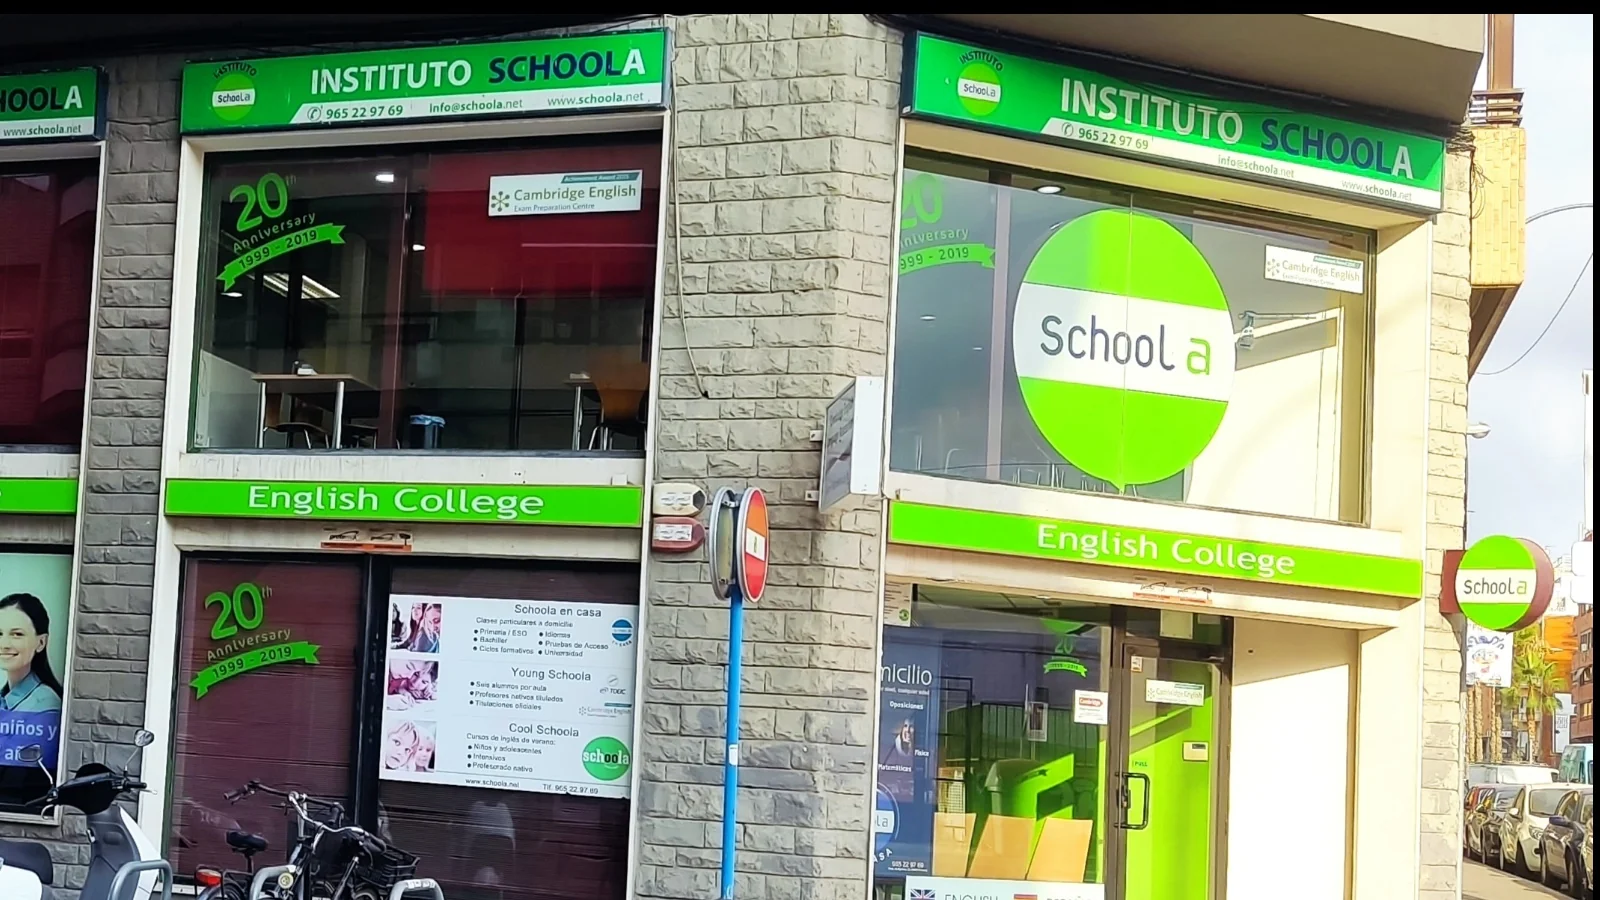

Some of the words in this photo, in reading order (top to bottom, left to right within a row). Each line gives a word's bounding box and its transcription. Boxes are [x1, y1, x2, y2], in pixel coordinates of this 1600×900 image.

[960, 50, 1003, 71] INSTITUTO
[213, 62, 257, 79] INSTITUTO
[311, 59, 472, 95] INSTITUTO
[489, 48, 646, 84] SCHOOLA
[326, 108, 349, 119] 965
[352, 107, 366, 118] 22
[370, 106, 385, 117] 97
[388, 105, 404, 116] 69
[547, 92, 644, 107] www.schoola.net
[3, 124, 82, 137] www.schoola.net
[1061, 76, 1244, 145] INSTITUTO
[1261, 118, 1414, 180] SCHOOLA
[1078, 127, 1099, 141] 965
[1101, 131, 1117, 145] 22
[1119, 135, 1132, 147] 97
[1135, 138, 1149, 150] 69
[1217, 155, 1295, 179] info@schoola.net
[1341, 180, 1412, 202] www.schoola.net
[514, 186, 585, 201] Cambridge
[589, 184, 636, 199] English
[533, 204, 571, 212] Preparation
[233, 212, 316, 254] Anniversary
[239, 247, 270, 269] 1999
[285, 229, 317, 249] 2019
[938, 246, 969, 260] 2019
[1282, 260, 1329, 277] Cambridge
[1330, 268, 1360, 282] English
[1040, 314, 1211, 376] Schoola
[249, 485, 378, 515] English
[393, 487, 544, 520] College
[1037, 523, 1158, 559] English
[1171, 538, 1296, 578] College
[1463, 577, 1527, 595] Schoola
[514, 604, 557, 615] Schoola
[560, 607, 573, 616] en
[576, 609, 602, 617] casa
[499, 618, 537, 627] particulares
[544, 620, 573, 628] domicilio
[479, 628, 507, 636] Primaria
[512, 629, 528, 637] ESO
[479, 636, 508, 644] Bachiller
[207, 628, 291, 661] Anniversary
[479, 645, 499, 653] Ciclos
[500, 646, 534, 655] formativos
[545, 640, 572, 648] Pruebas
[584, 642, 609, 650] Acceso
[544, 649, 583, 657] Universidad
[212, 658, 244, 679] 1999
[260, 646, 292, 662] 2019
[511, 666, 545, 681] Young
[548, 669, 591, 681] Schoola
[491, 682, 519, 690] alumnos
[520, 684, 531, 692] por
[475, 690, 510, 699] Profesores
[511, 692, 534, 701] nativos
[535, 694, 564, 703] titulados
[475, 699, 514, 709] Titulaciones
[514, 702, 542, 711] oficiales
[889, 700, 924, 710] Oposiciones
[0, 719, 44, 737] niños
[47, 725, 58, 741] y
[466, 732, 489, 740] Cursos
[509, 722, 533, 734] Cool
[536, 724, 579, 737] Schoola
[473, 753, 506, 762] Intensivos
[499, 746, 542, 755] adolescentes
[582, 748, 630, 765] schoola
[472, 762, 512, 771] Profesorado
[513, 765, 533, 773] nativo
[465, 779, 520, 788] www.schoola.net
